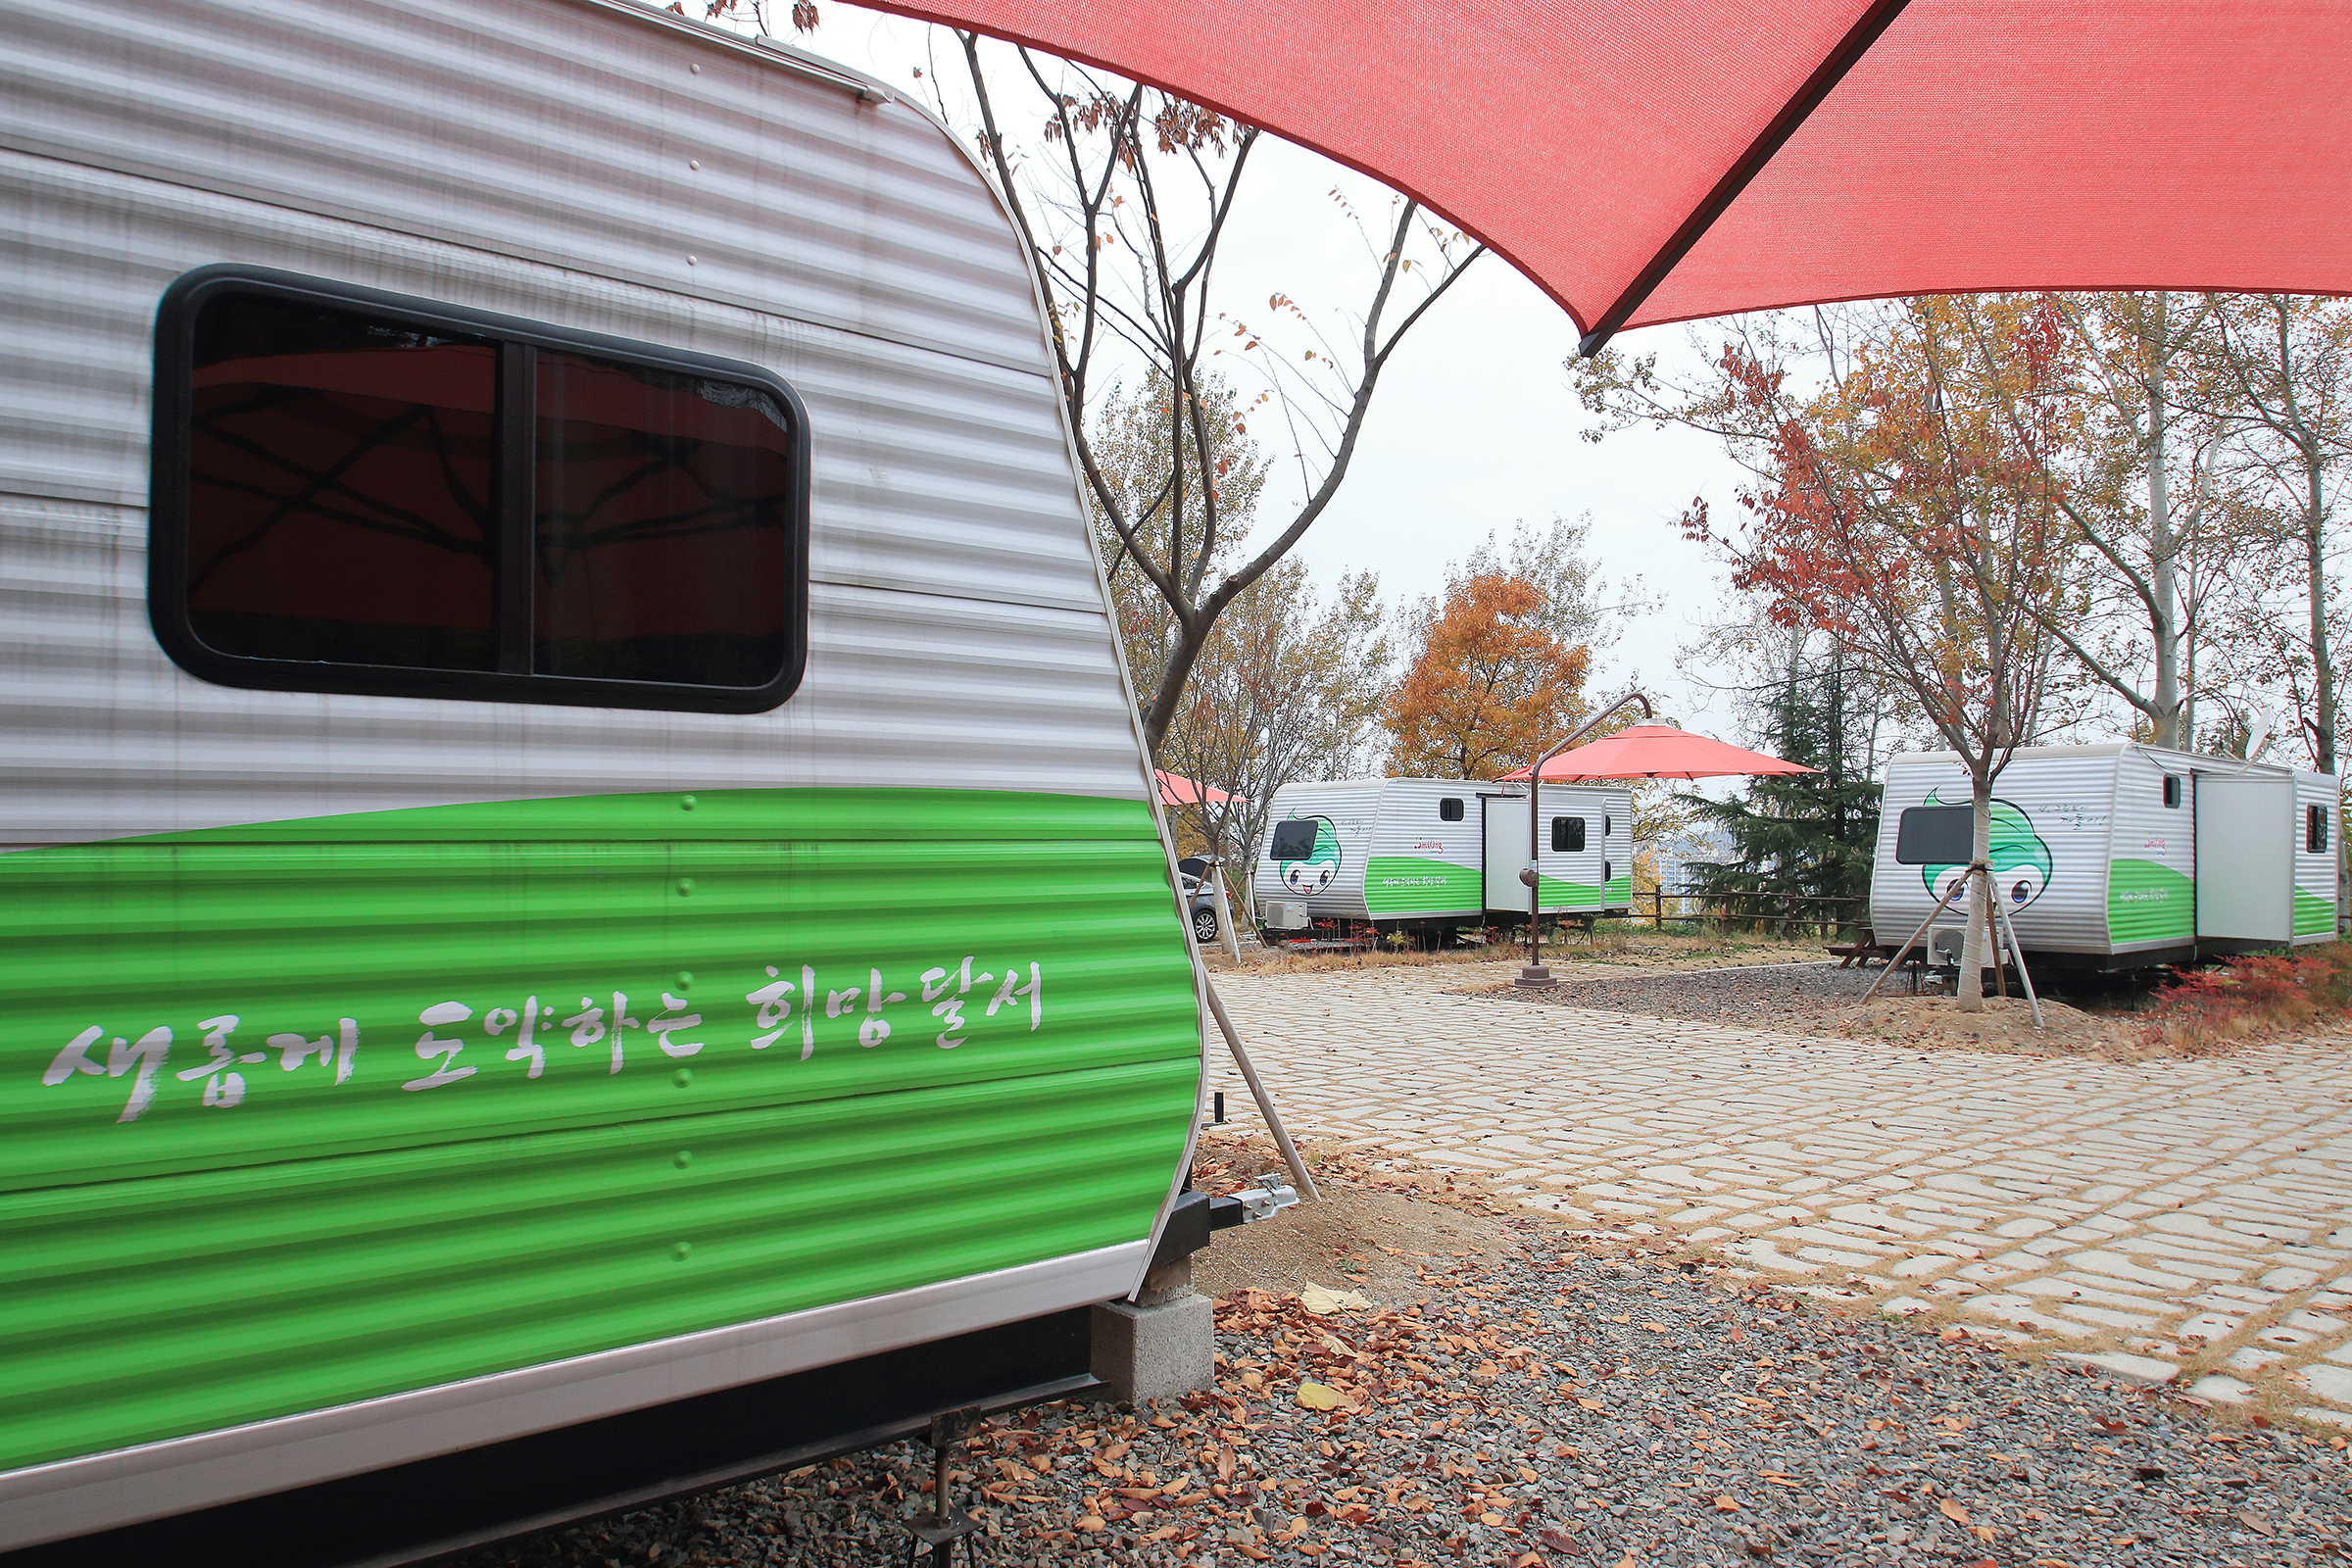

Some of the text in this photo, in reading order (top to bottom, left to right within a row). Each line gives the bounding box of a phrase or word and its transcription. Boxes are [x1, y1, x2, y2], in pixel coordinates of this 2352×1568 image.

[42, 955, 1043, 1124] 새롭게 도약하는 희망 달서
